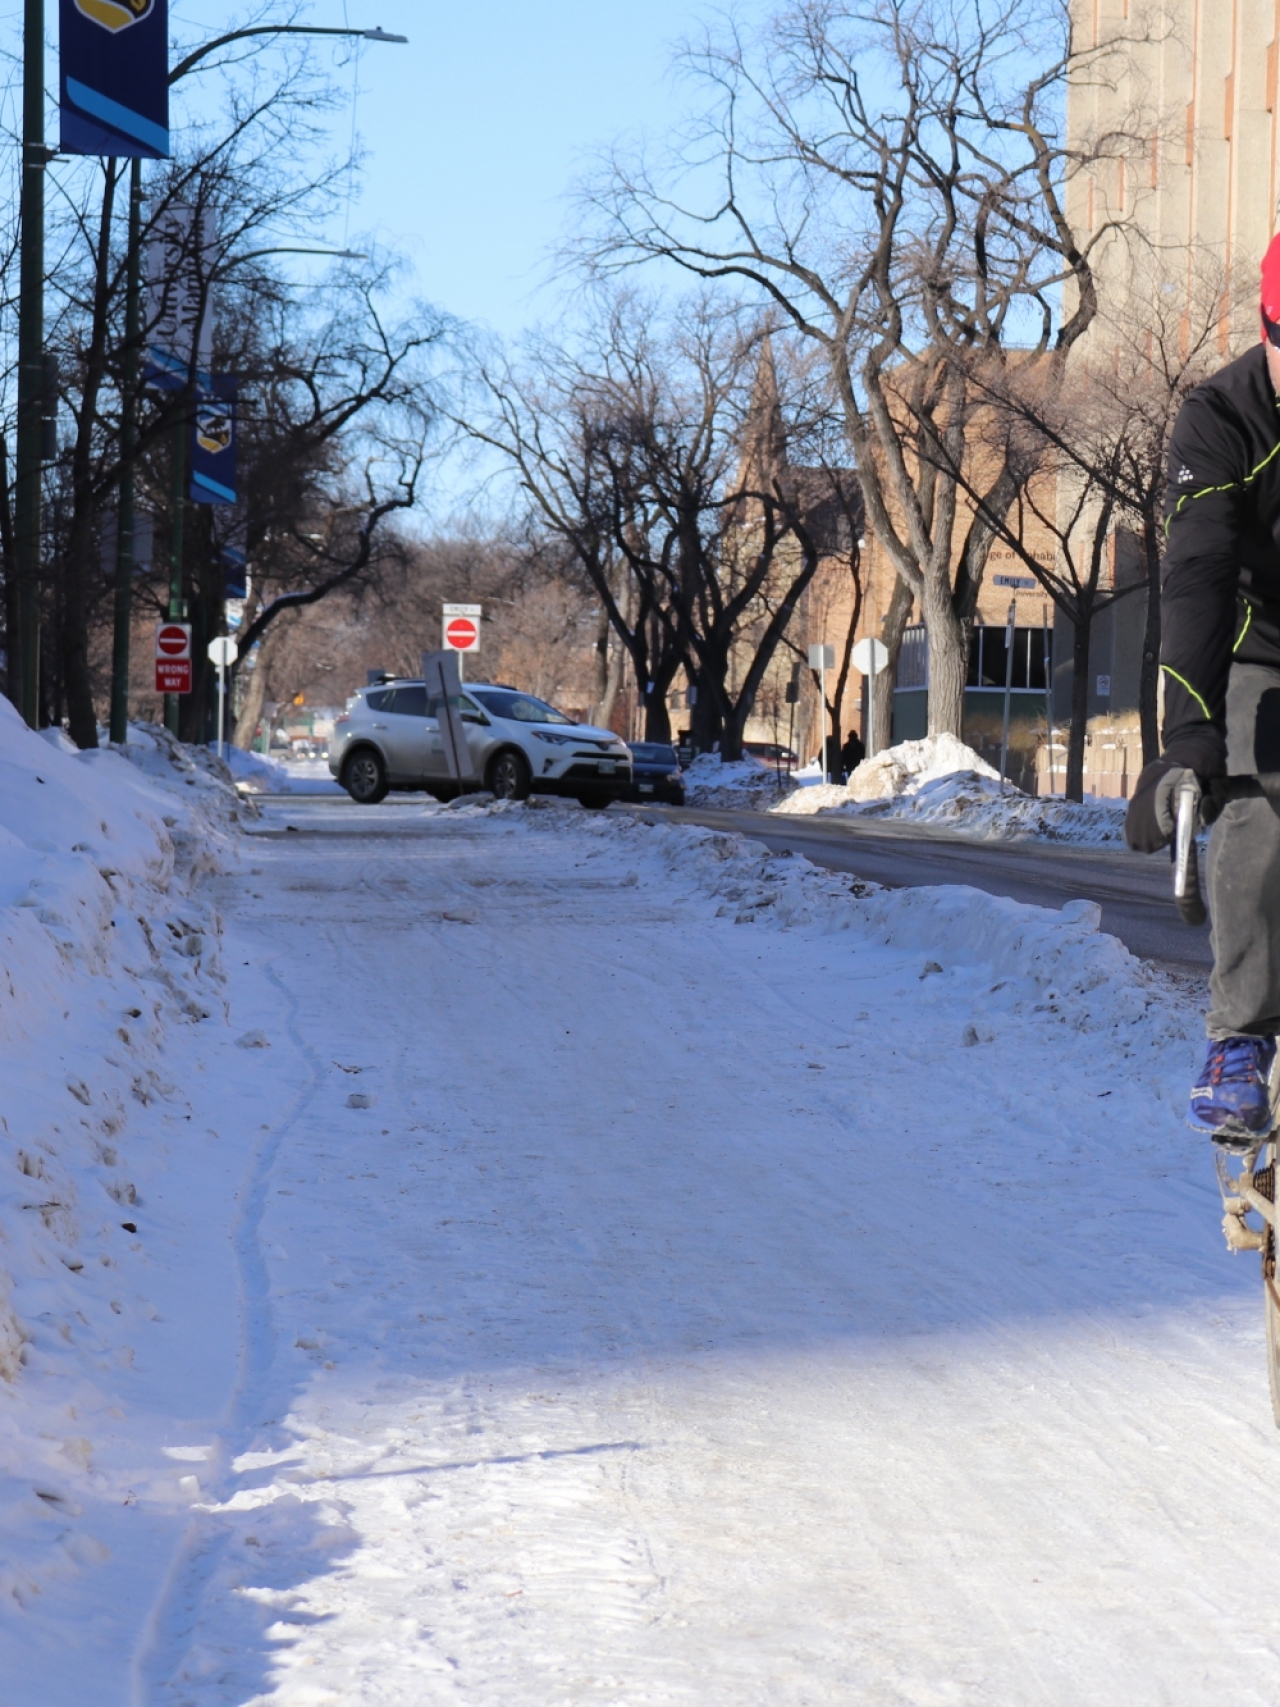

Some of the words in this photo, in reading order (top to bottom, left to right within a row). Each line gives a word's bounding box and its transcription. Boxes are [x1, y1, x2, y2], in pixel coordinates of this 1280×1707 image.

[182, 218, 204, 326] Manitba
[1000, 576, 1021, 586] EMILY
[158, 665, 188, 674] WRONG
[164, 678, 181, 686] WAY
